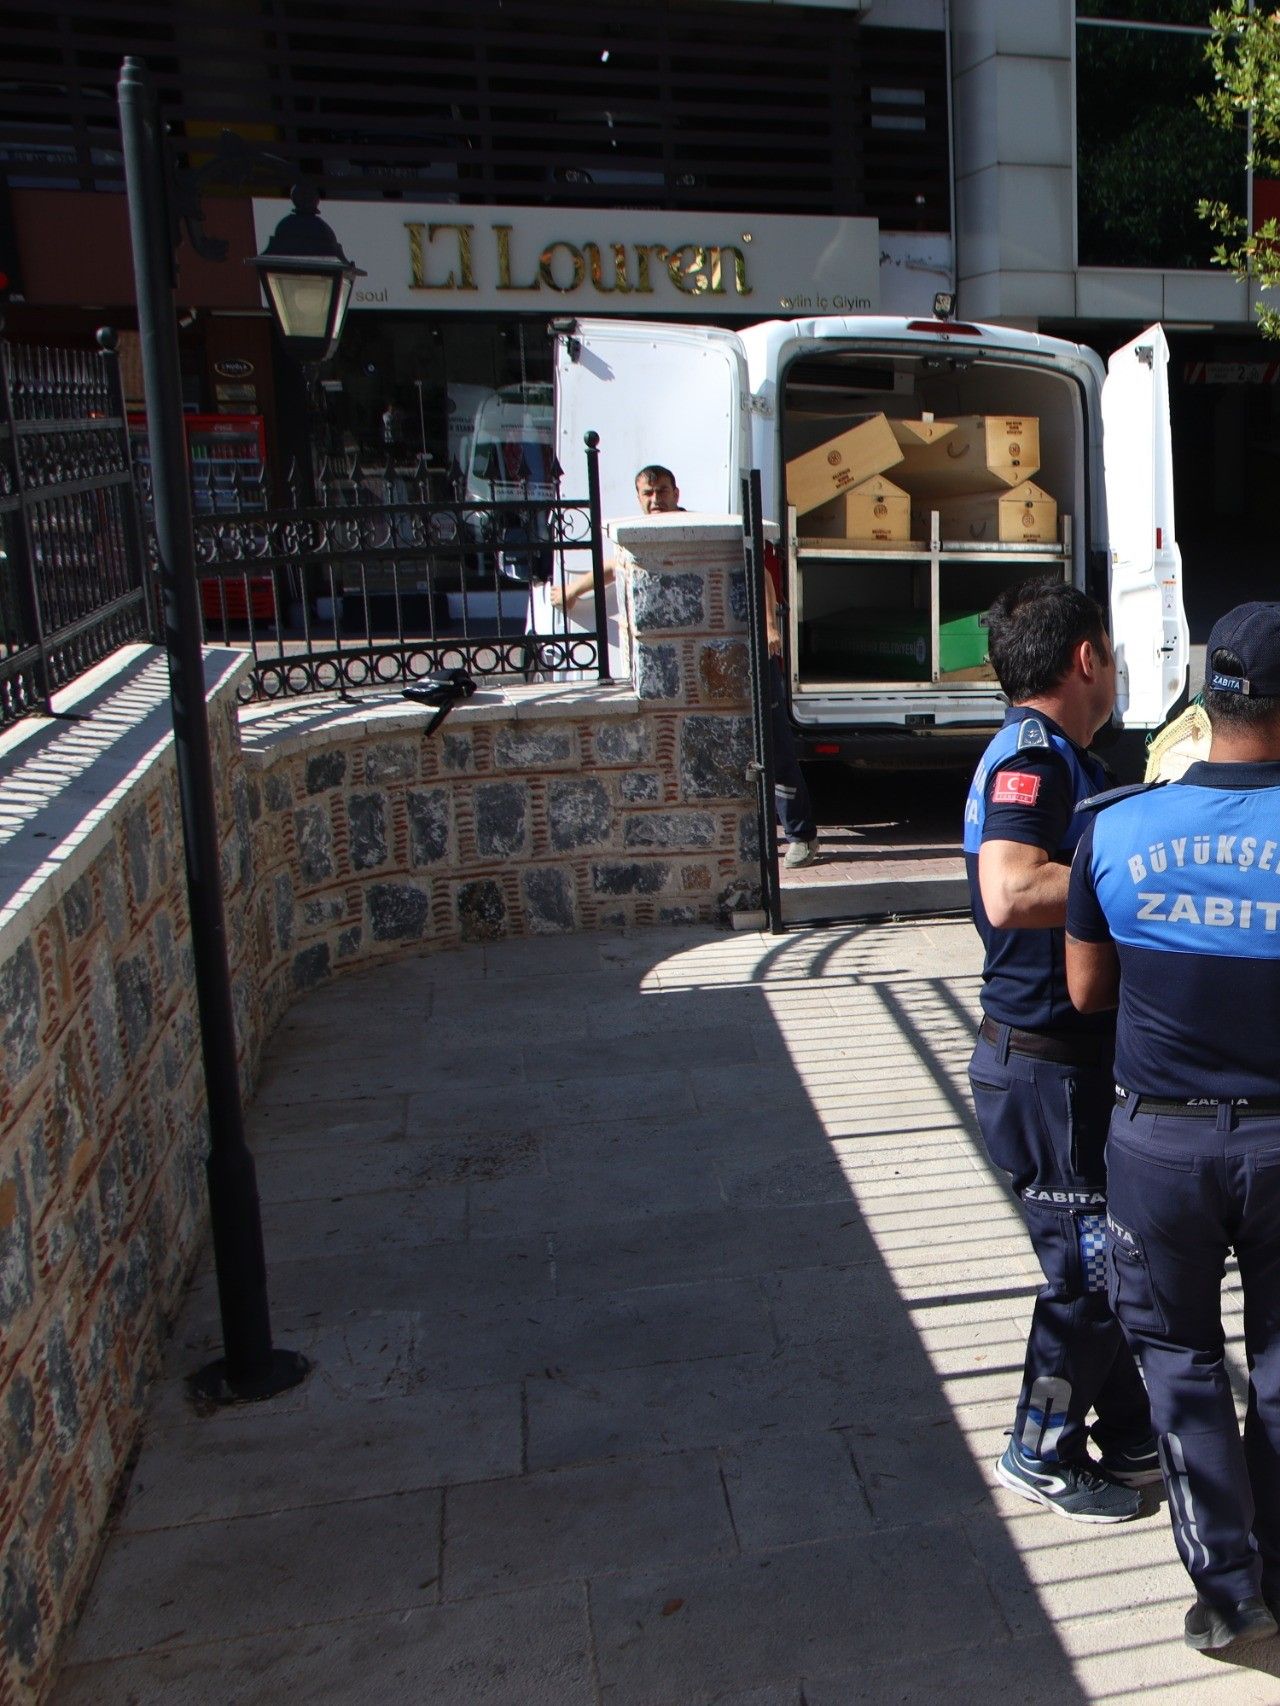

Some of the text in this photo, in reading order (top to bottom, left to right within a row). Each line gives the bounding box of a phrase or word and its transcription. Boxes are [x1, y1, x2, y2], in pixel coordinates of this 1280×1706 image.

[355, 288, 388, 302] soul
[832, 294, 871, 311] Giyim
[1212, 674, 1241, 690] ZABITA
[1025, 1187, 1106, 1204] ZABITA
